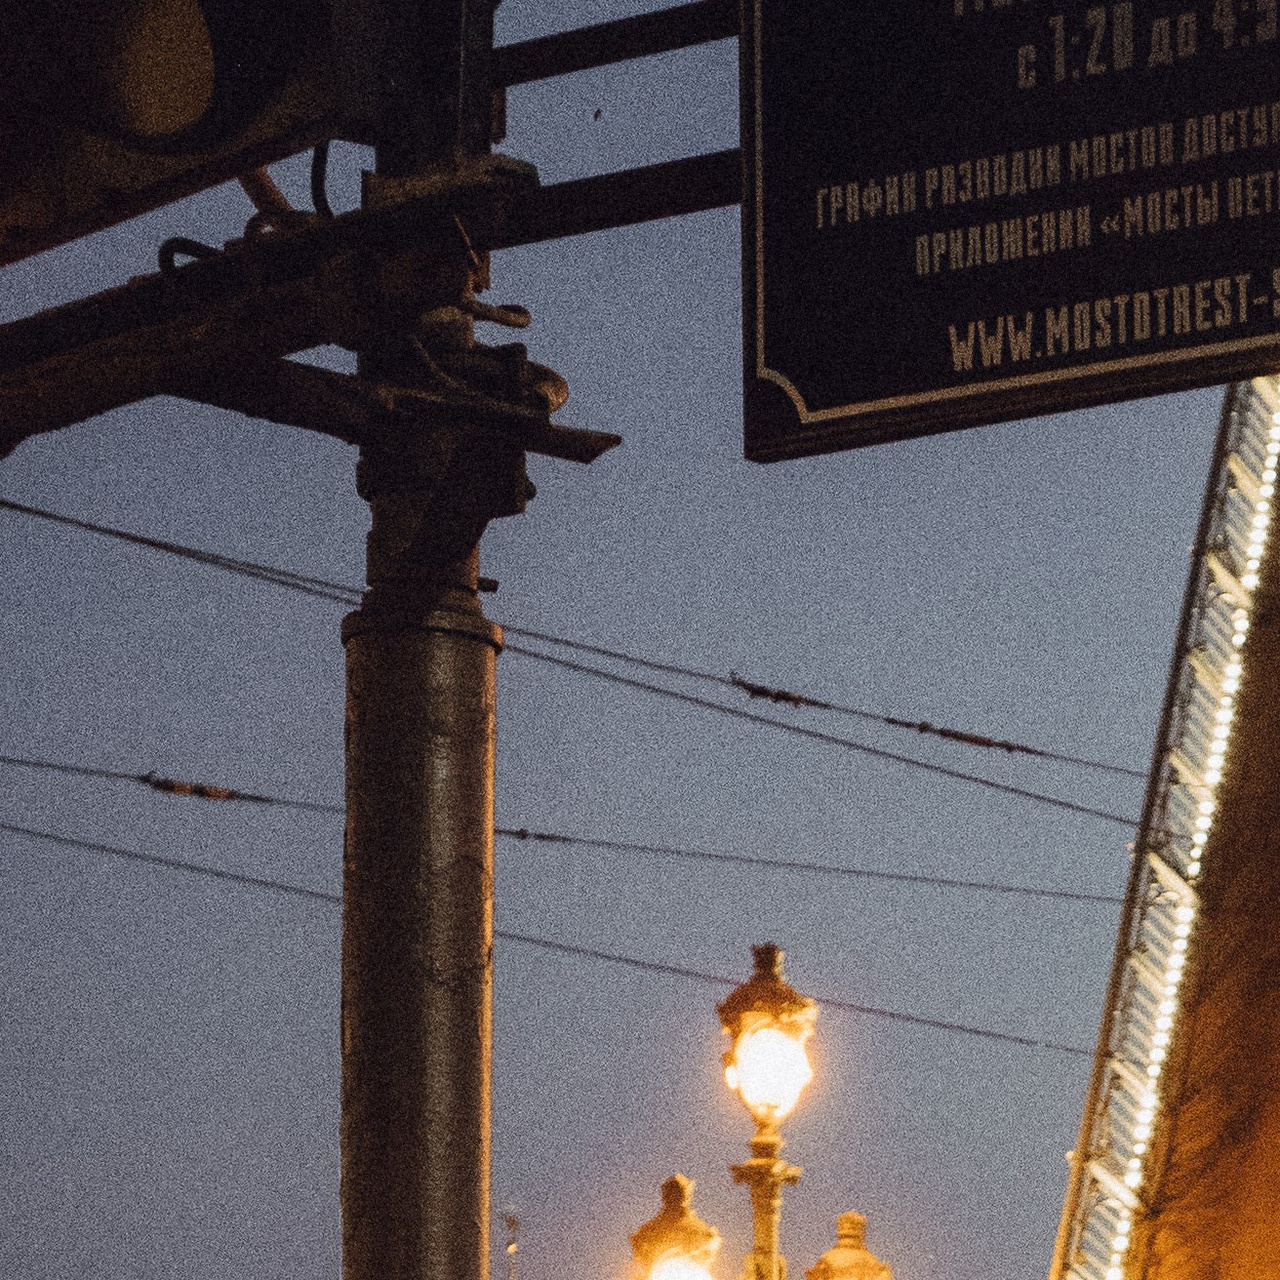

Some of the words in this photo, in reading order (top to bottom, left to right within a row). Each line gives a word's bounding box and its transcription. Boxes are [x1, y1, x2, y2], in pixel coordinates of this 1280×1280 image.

[1048, 1, 1134, 83] 1:20
[816, 172, 917, 229] ГРАФИК
[925, 144, 1061, 210] РАЗВОДКИ
[1069, 121, 1174, 183] МОСТОВ
[914, 204, 1092, 277] ПРИЛОЖЕНИИ
[1100, 180, 1219, 240] «МОСТЫ
